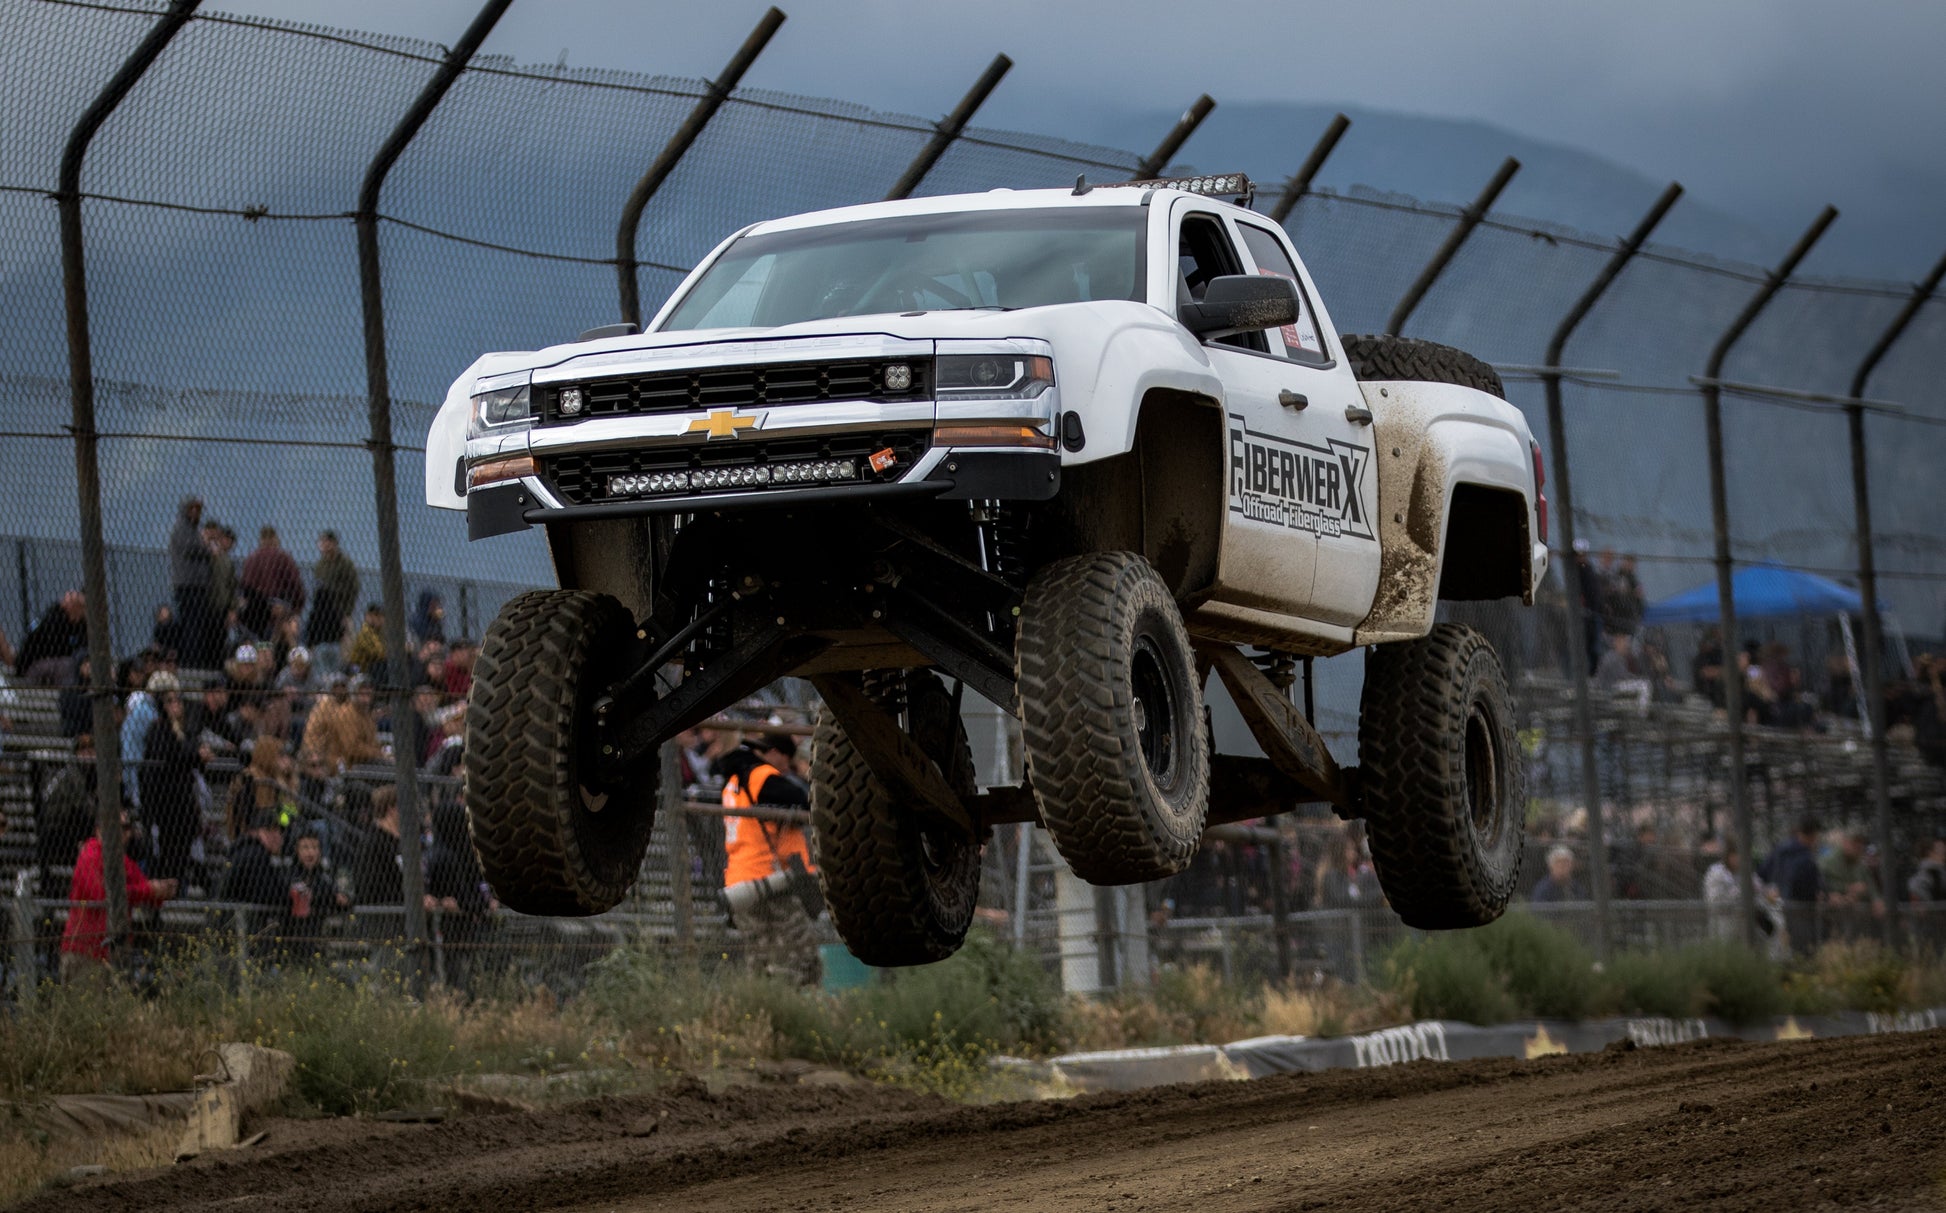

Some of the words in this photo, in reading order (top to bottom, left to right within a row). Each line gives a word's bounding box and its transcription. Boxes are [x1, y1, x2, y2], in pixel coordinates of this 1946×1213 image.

[1230, 428, 1361, 523] FIBERWERX
[1242, 493, 1284, 525] Offroad
[1288, 502, 1341, 537] Fiberglass
